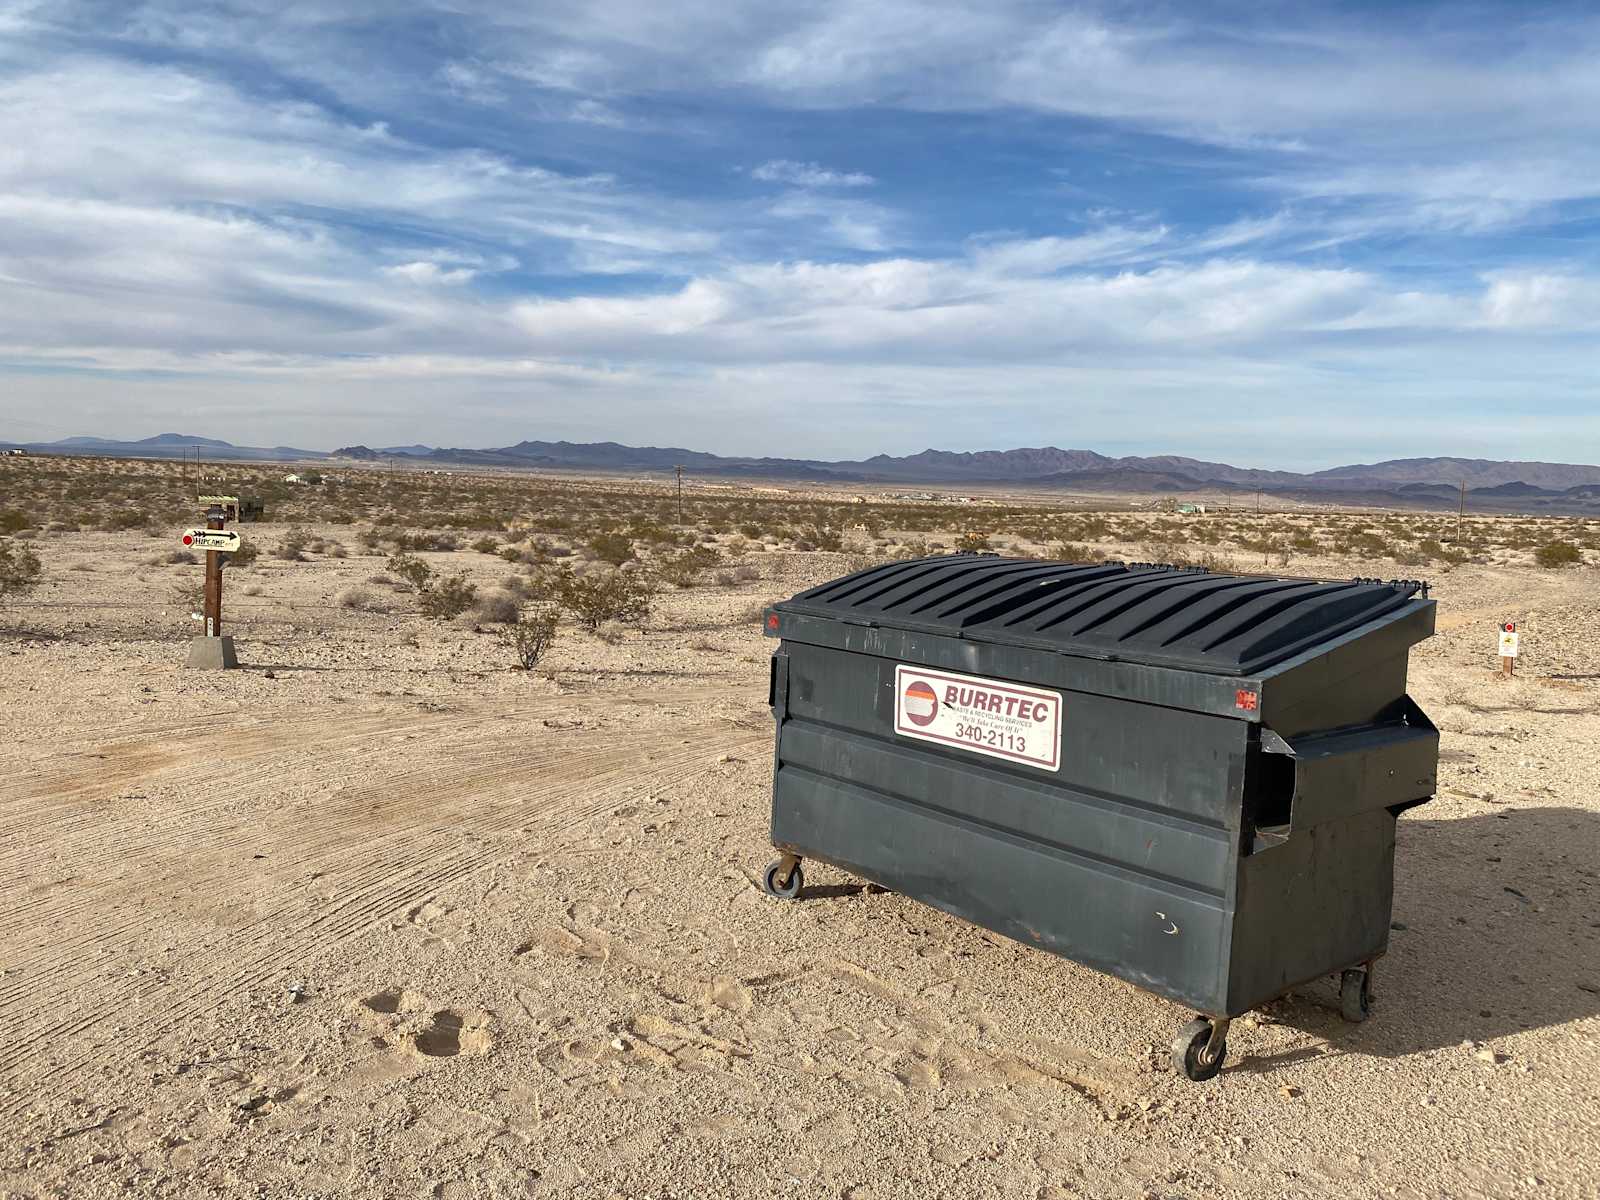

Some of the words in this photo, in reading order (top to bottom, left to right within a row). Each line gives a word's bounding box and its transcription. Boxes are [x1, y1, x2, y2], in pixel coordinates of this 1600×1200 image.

[945, 686, 1048, 723] BURRTEC
[975, 710, 1004, 722] RECYCLING
[1005, 717, 1032, 728] SERVICES
[955, 722, 1026, 752] 340-2113
